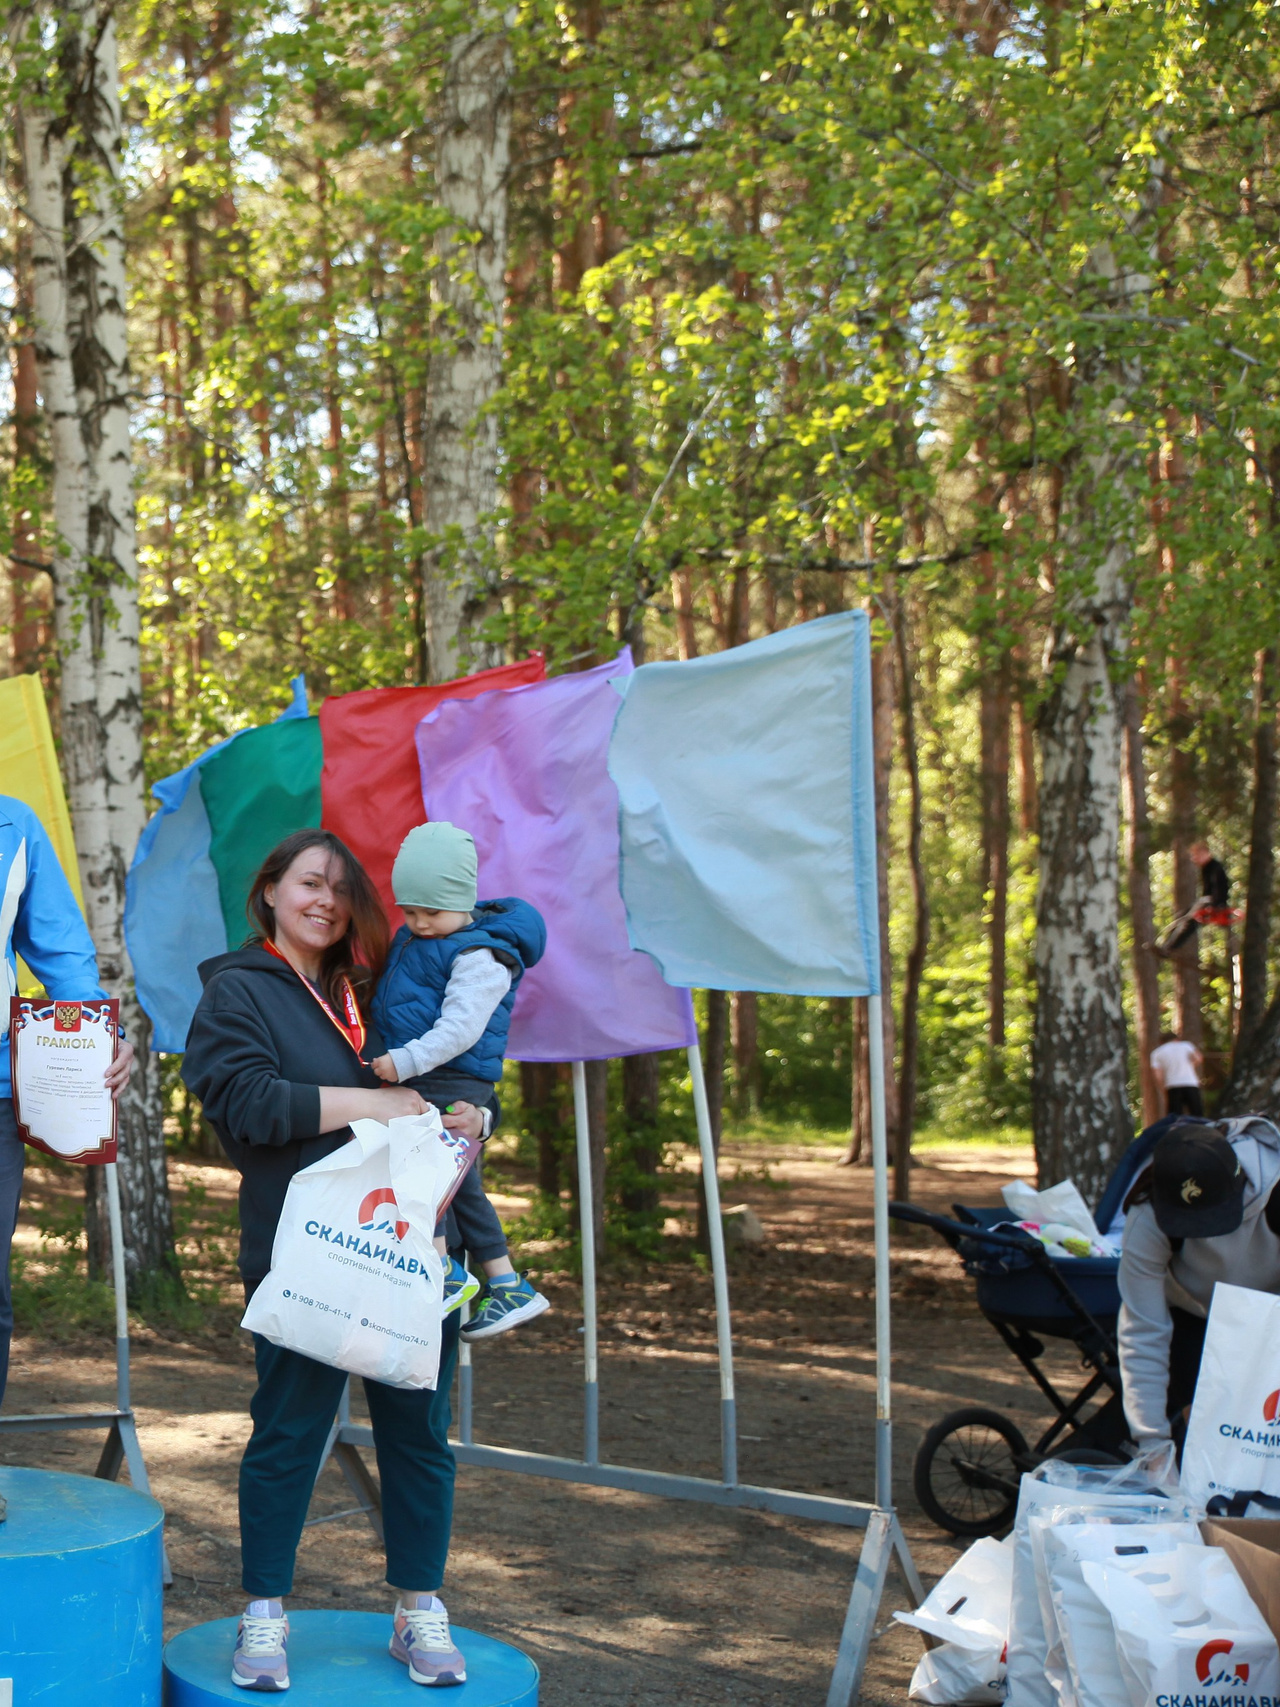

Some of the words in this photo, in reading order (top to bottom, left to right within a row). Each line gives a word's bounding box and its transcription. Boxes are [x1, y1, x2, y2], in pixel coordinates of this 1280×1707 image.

[36, 1035, 96, 1049] ГРАМОТА
[304, 1220, 431, 1282] СКАНДИНАВИ
[328, 1251, 381, 1277] спортивный
[292, 1292, 297, 1300] 8
[298, 1295, 314, 1306] 908
[315, 1301, 351, 1320] 708-41-14
